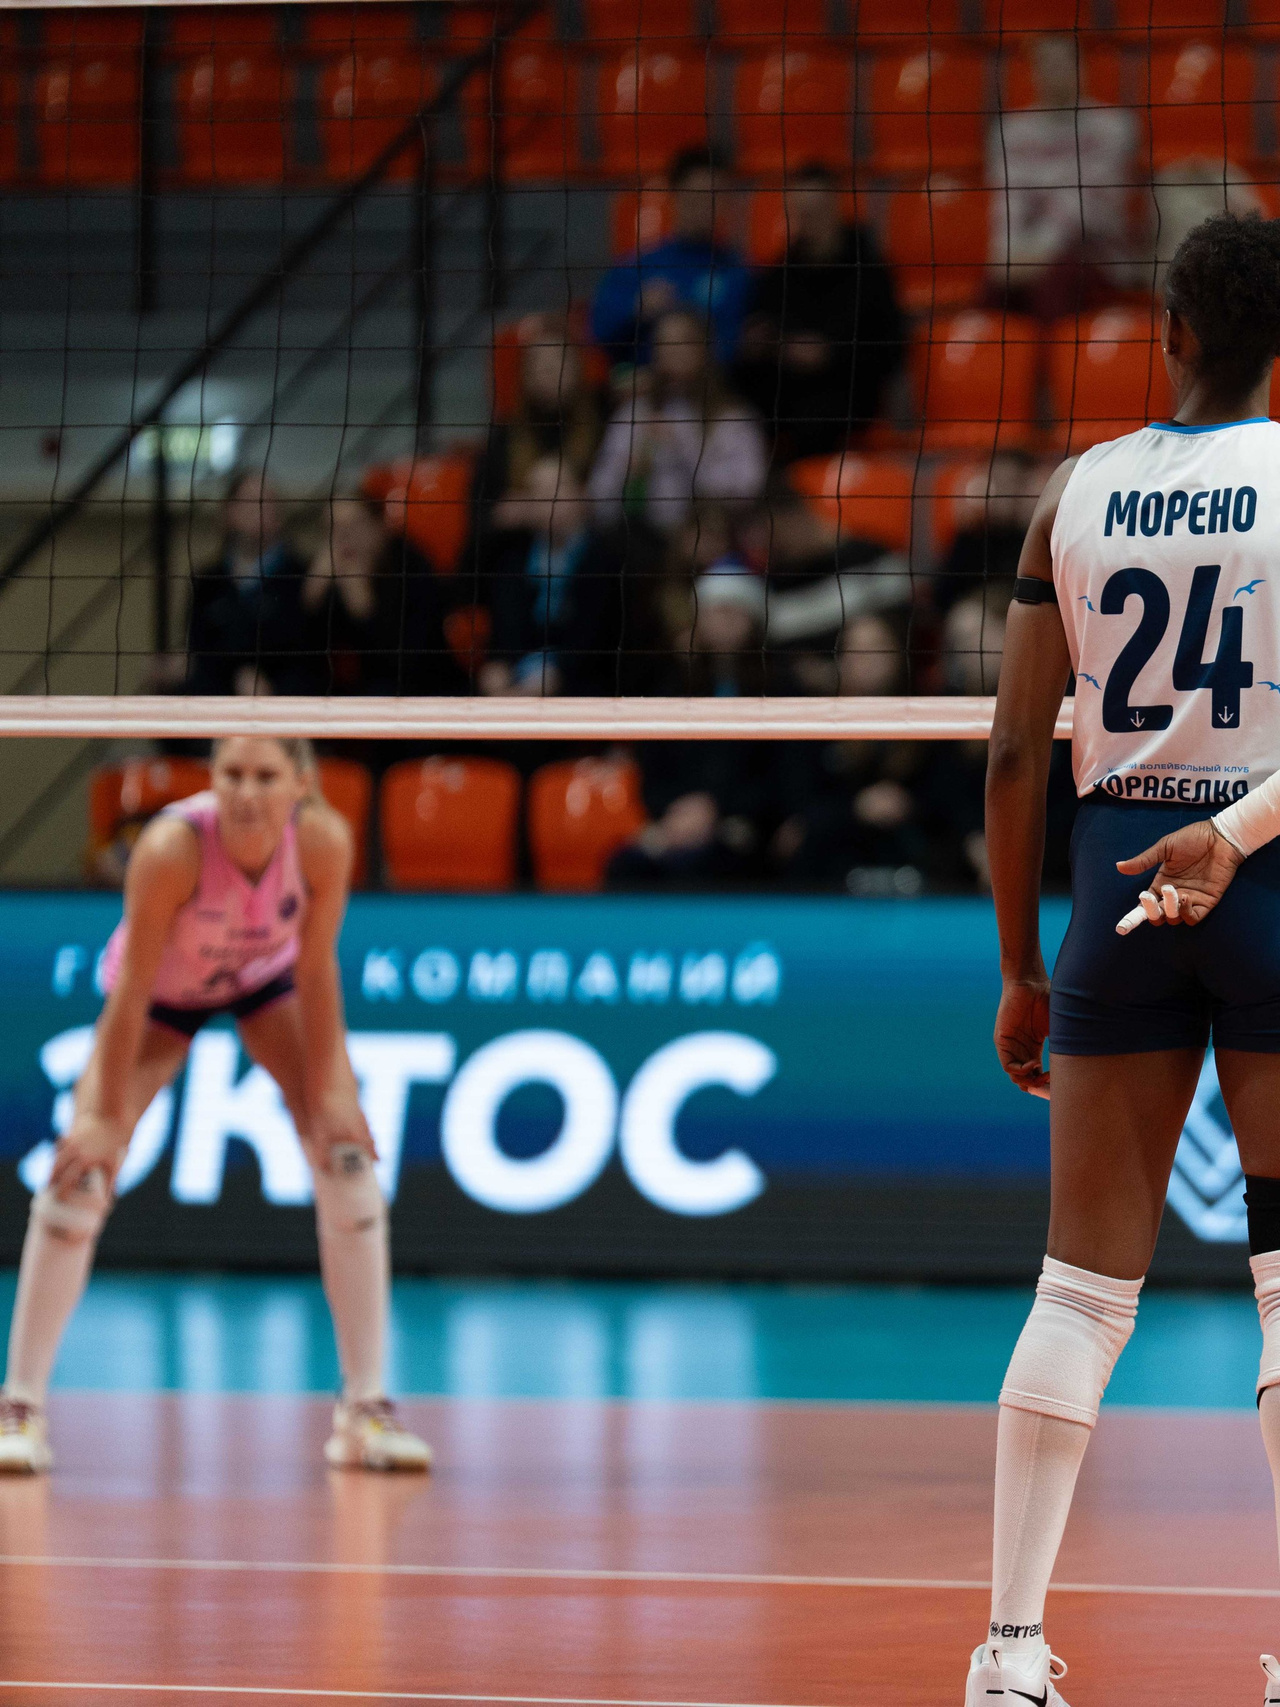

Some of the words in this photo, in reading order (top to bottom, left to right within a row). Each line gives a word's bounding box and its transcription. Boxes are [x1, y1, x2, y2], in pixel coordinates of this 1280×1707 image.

[1103, 485, 1257, 537] МОРЕНО
[1100, 564, 1253, 733] 24
[1139, 763, 1221, 772] ВОЛЕЙБОЛЬНЫЙ
[361, 943, 783, 1004] КОМПАНИЙ
